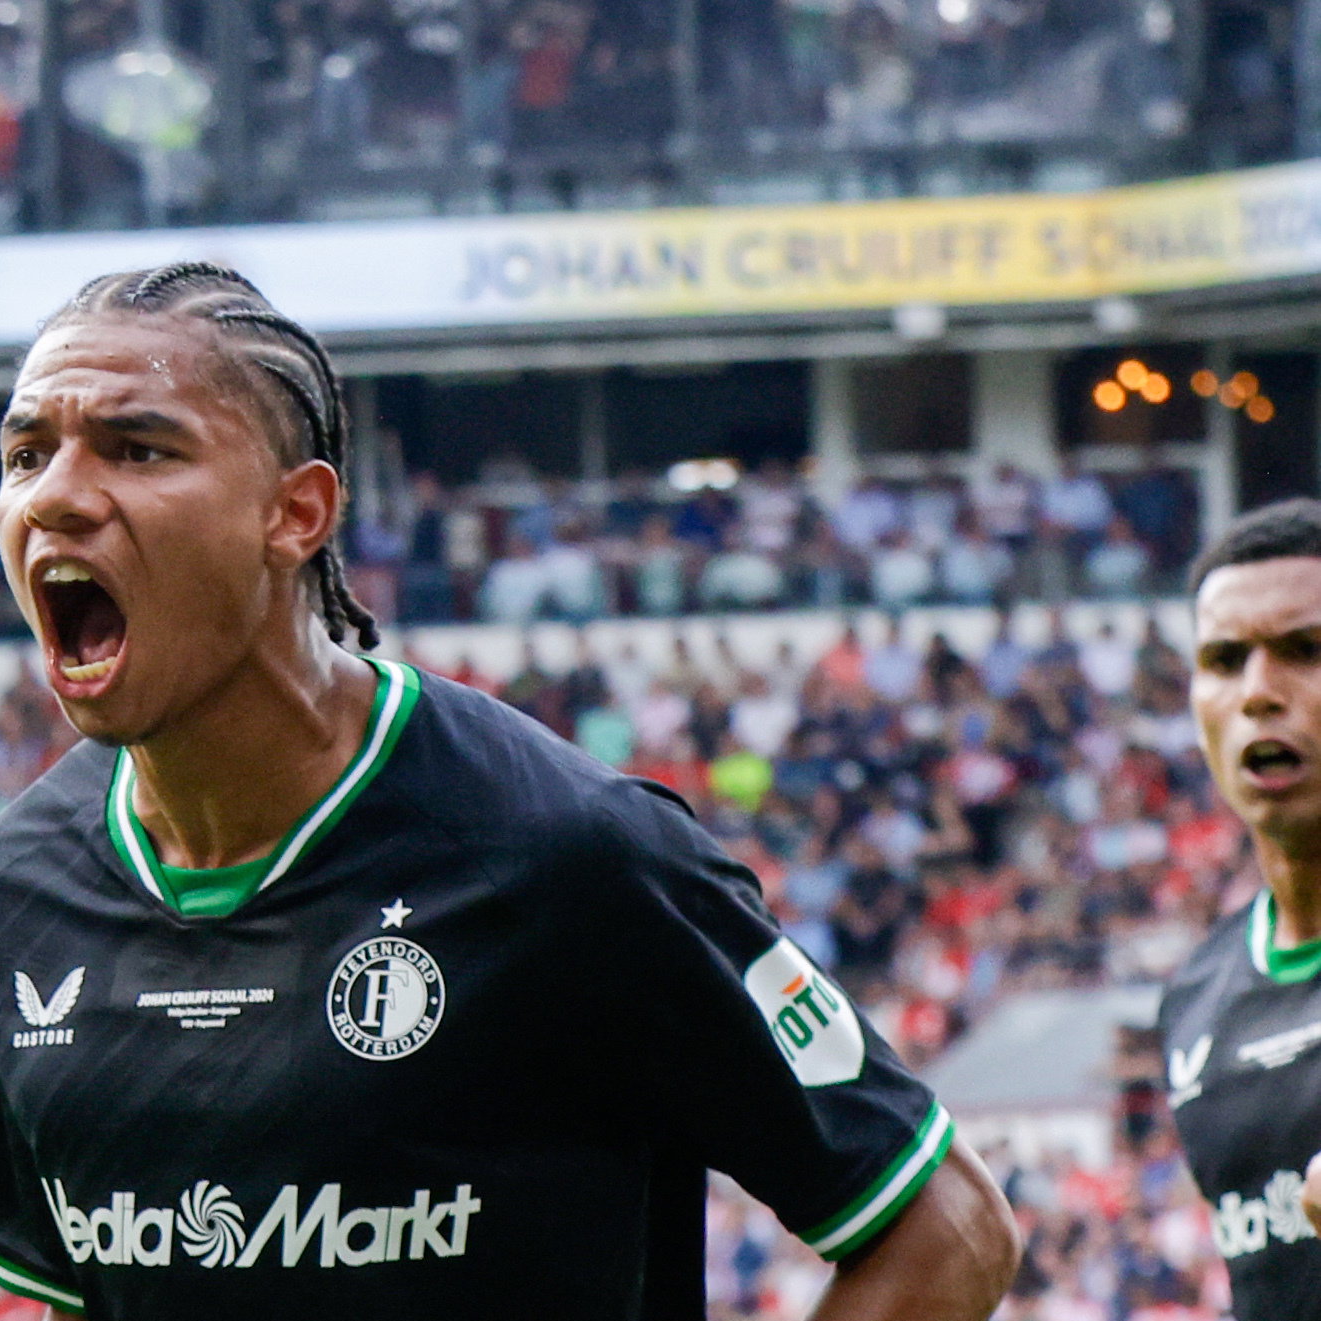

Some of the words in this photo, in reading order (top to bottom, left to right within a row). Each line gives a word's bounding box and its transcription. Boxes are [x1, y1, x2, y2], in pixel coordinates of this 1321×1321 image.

[461, 228, 703, 301] JOHAN
[723, 212, 1015, 288] CRUIJFF
[338, 941, 438, 985] FEYENOORD
[12, 1027, 75, 1049] CASTORE
[333, 1011, 435, 1056] ROTTERDAM
[235, 1182, 482, 1268] Markt
